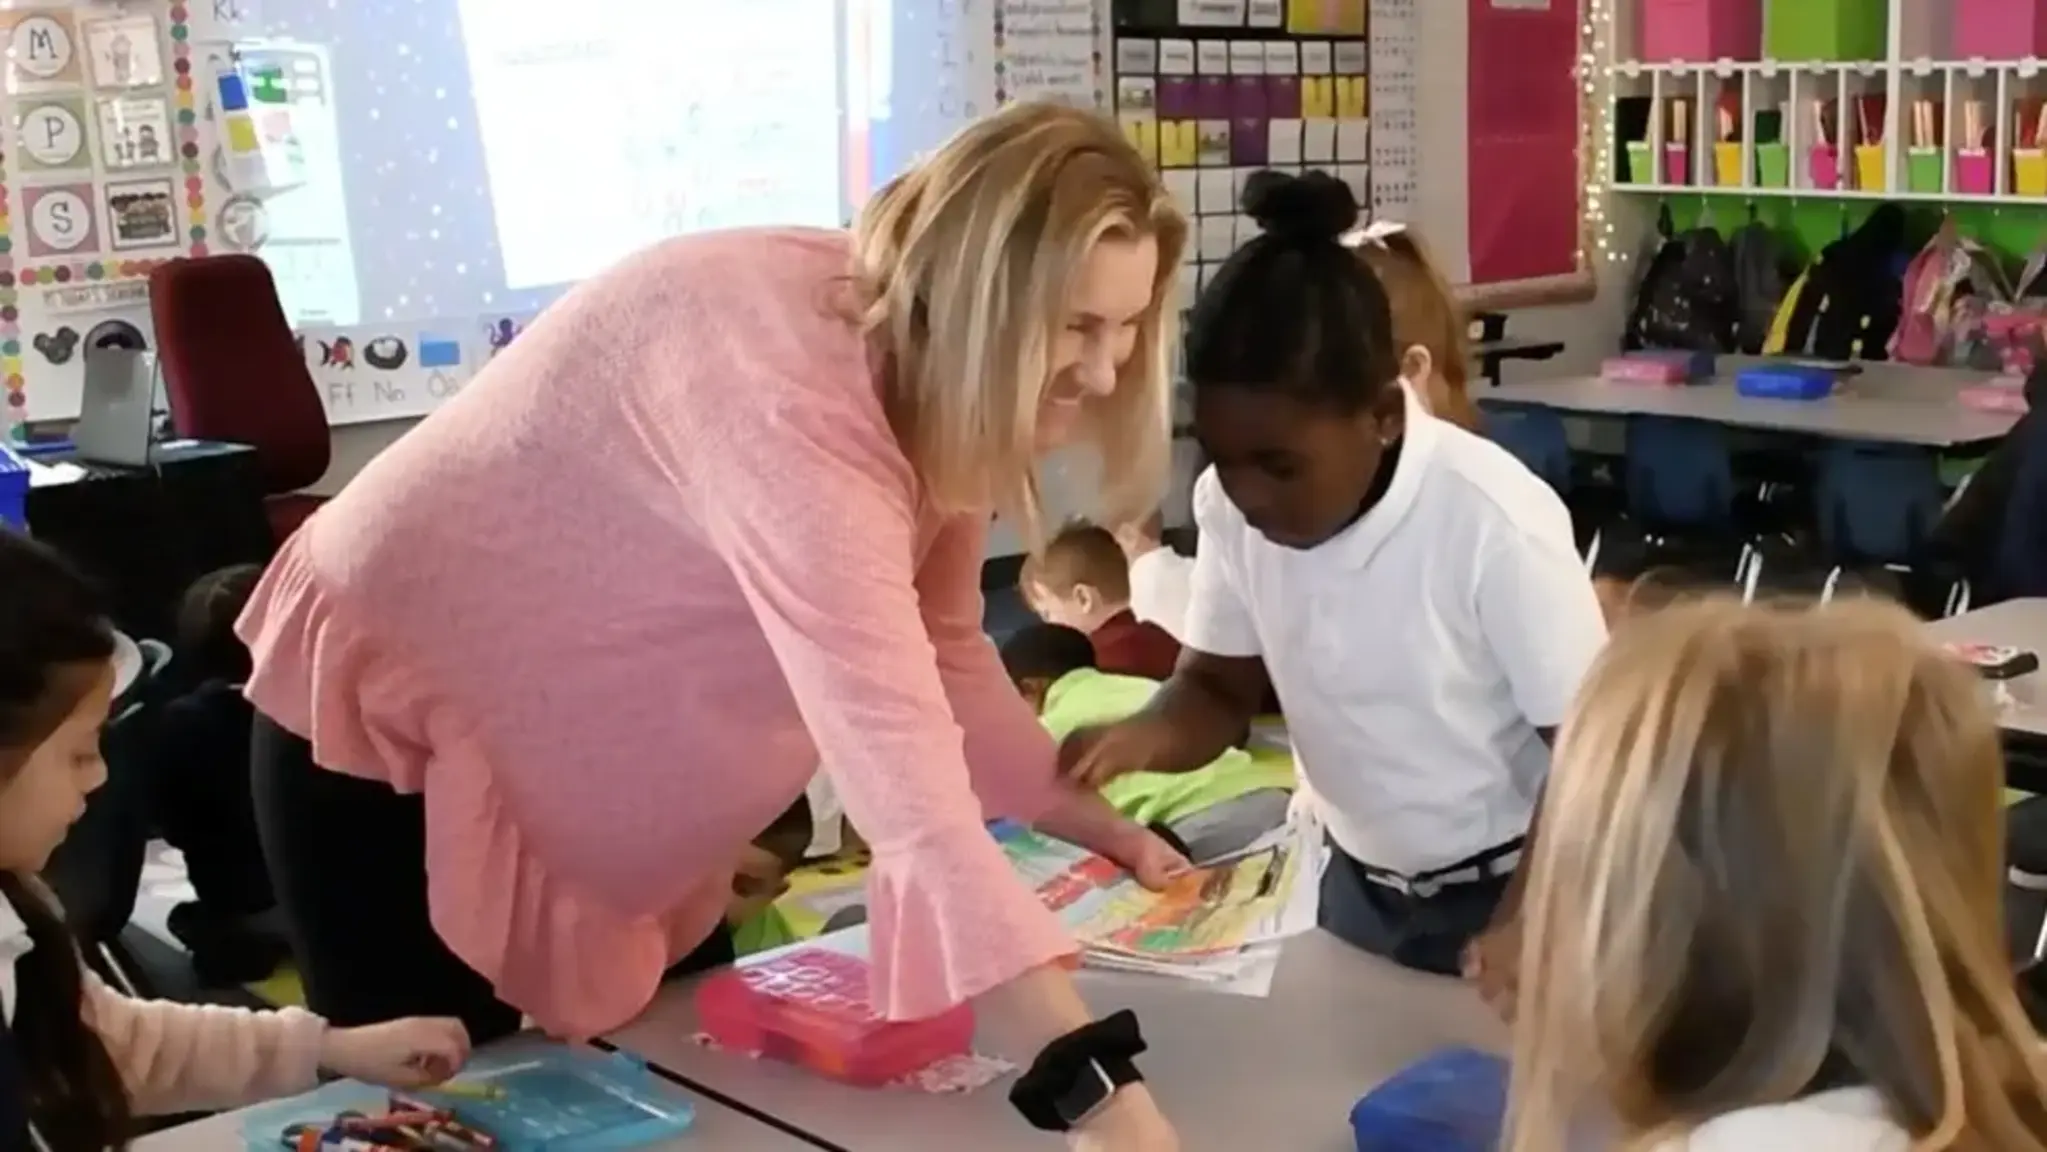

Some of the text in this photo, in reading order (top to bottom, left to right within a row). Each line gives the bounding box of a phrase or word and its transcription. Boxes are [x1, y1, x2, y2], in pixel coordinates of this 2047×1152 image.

[29, 27, 59, 60] M
[44, 116, 65, 149] P
[50, 200, 73, 234] S
